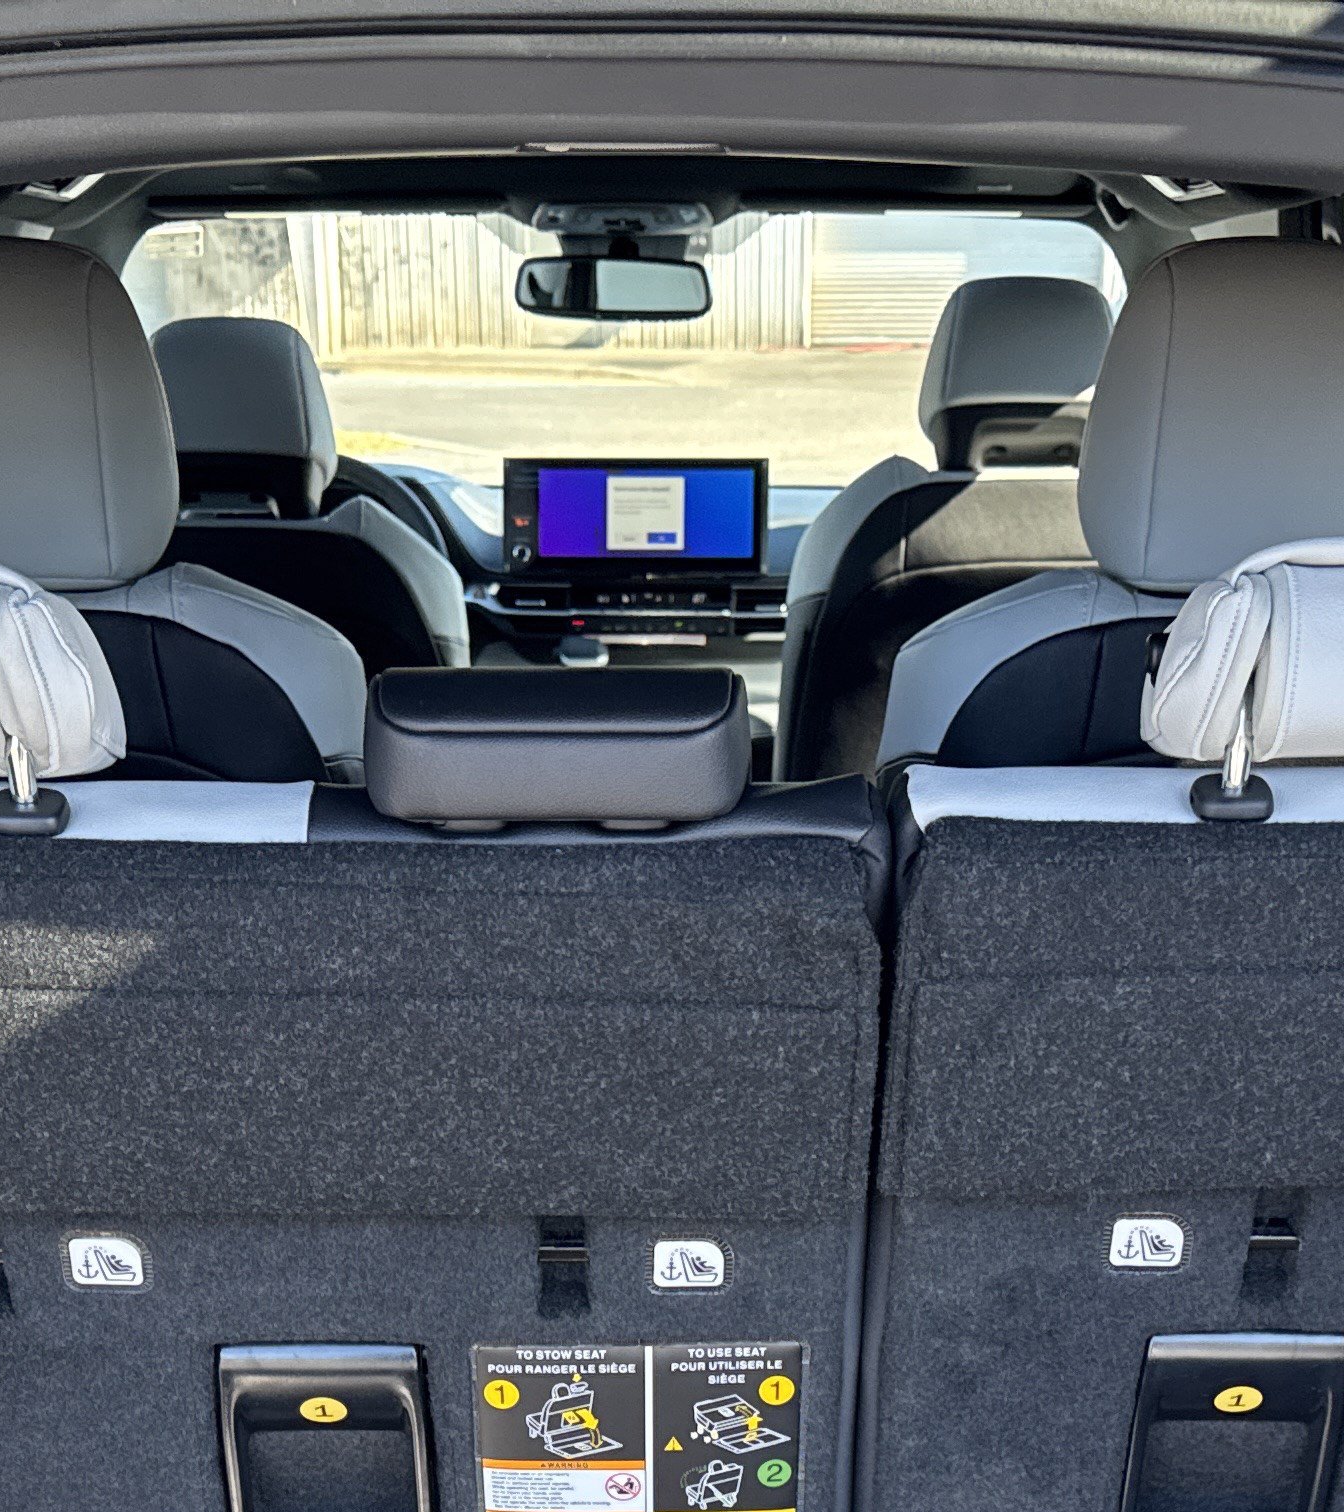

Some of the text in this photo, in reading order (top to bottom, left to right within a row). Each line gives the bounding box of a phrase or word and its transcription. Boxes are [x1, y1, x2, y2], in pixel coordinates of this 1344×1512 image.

[516, 1350, 607, 1360] TO STOW SEAT
[688, 1347, 767, 1358] TO USE SEAT
[488, 1362, 636, 1374] POUR RANGER LE SIÈGE
[671, 1360, 783, 1371] POUR UTILISER LE
[708, 1373, 745, 1384] SIÈGE
[494, 1385, 505, 1405] 1
[770, 1381, 780, 1401] 1
[1227, 1394, 1246, 1407] 1
[314, 1405, 335, 1418] 1
[767, 1463, 783, 1482] 2
